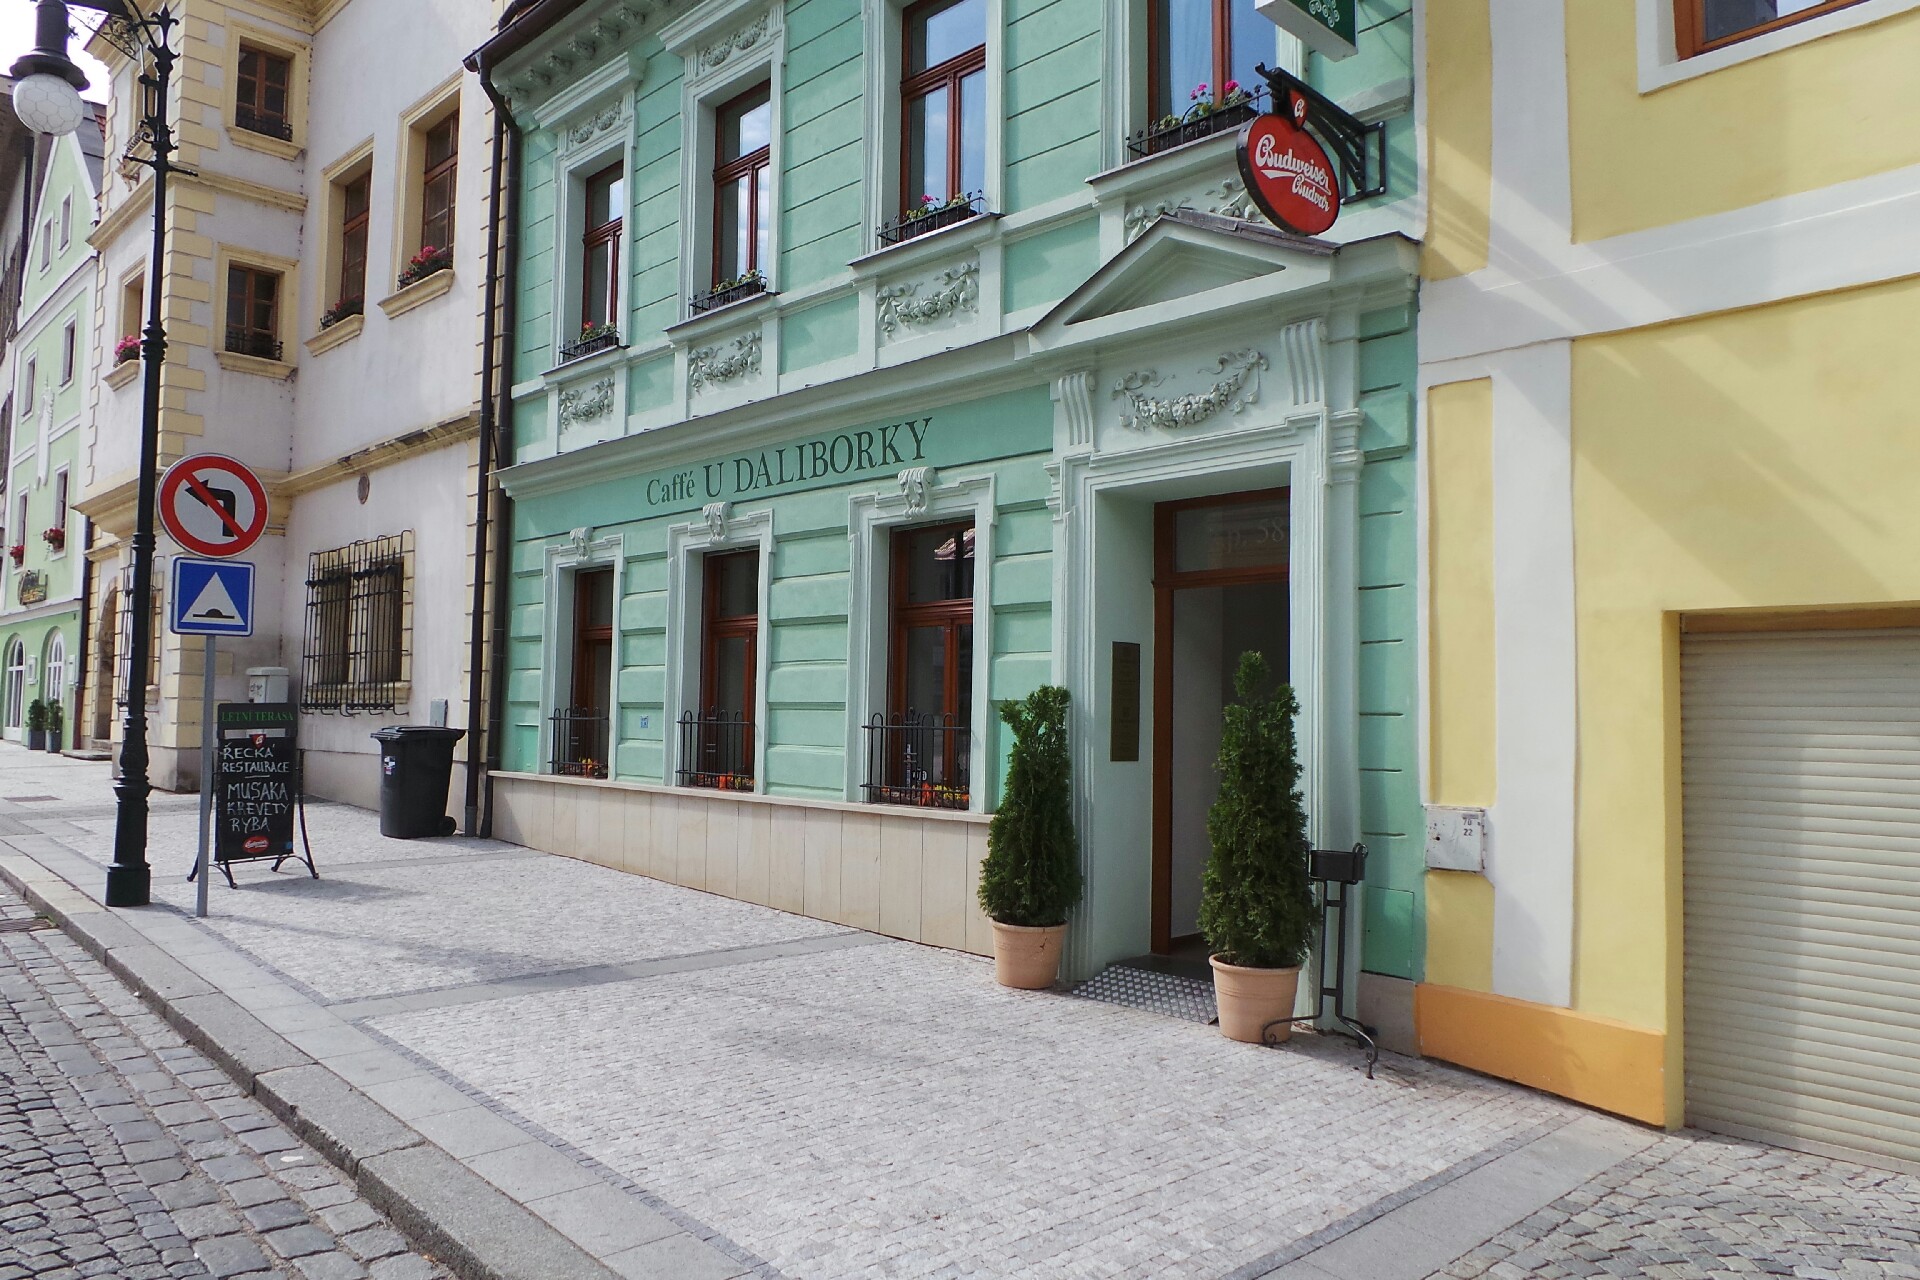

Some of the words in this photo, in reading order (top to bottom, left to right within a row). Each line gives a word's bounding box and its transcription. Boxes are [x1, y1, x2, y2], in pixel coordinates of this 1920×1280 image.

[1255, 134, 1331, 192] Budweiser
[1292, 174, 1330, 212] Budvar
[646, 470, 695, 506] Caffé
[703, 462, 724, 498] U
[733, 416, 933, 493] DALIBORKY
[1257, 516, 1285, 543] 58
[254, 711, 294, 721] TERASA
[223, 742, 275, 760] ŘECKÁ
[221, 761, 290, 773] RESTAURACE
[227, 781, 289, 801] MUSAKA
[226, 802, 290, 817] KREVETY
[229, 817, 271, 834] RYBA
